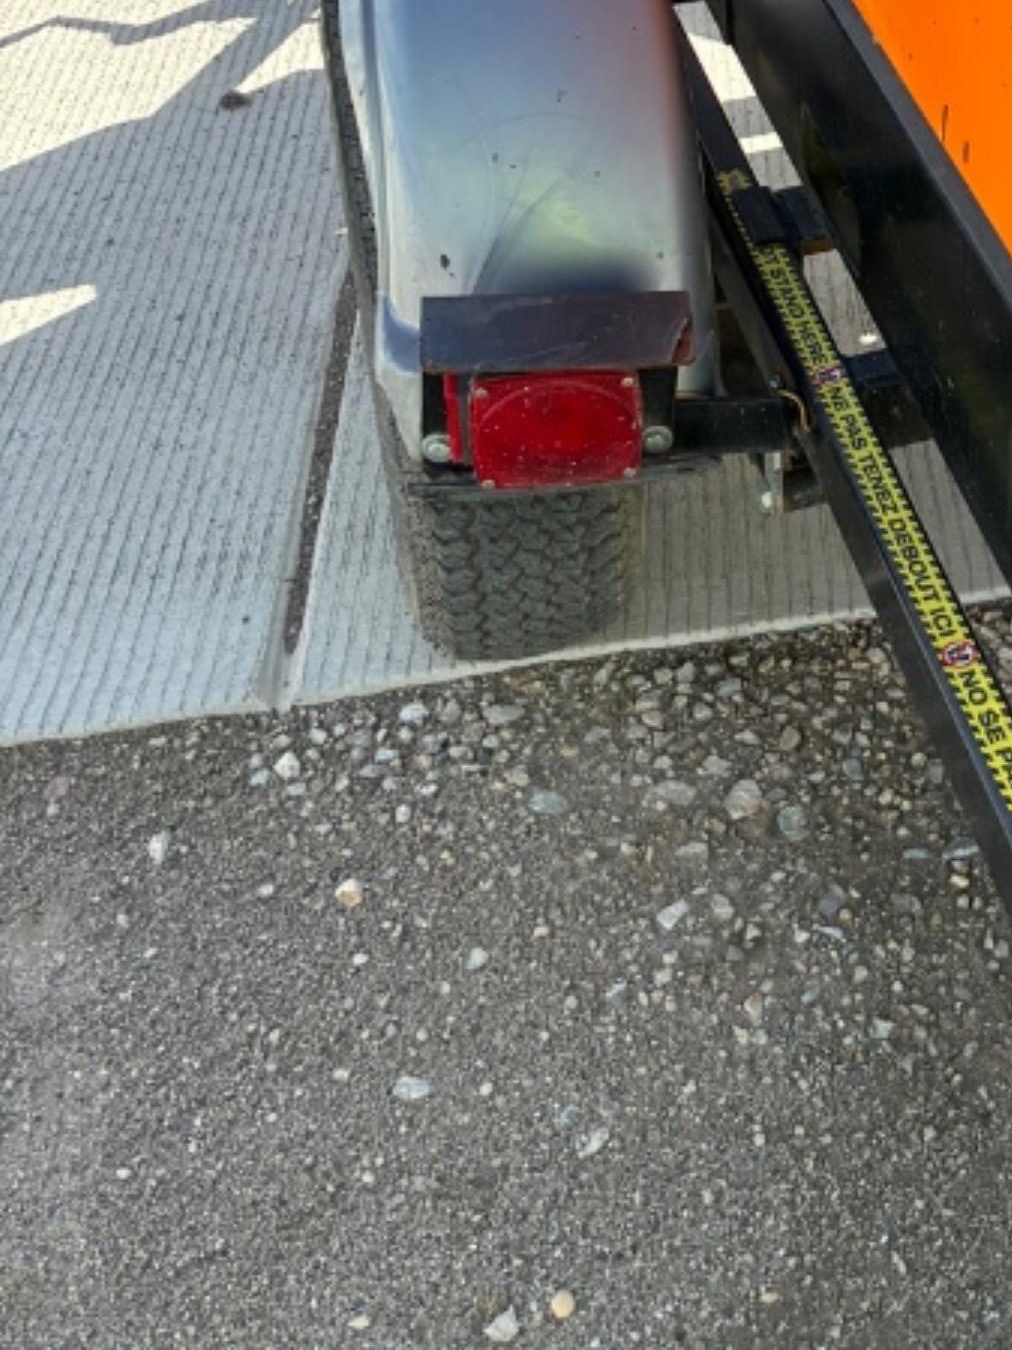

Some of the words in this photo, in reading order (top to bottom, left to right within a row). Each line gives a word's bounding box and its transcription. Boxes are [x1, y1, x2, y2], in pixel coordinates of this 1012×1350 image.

[842, 414, 867, 450] PAS
[888, 517, 940, 602] DEBOUT
[960, 672, 987, 705] NO
[978, 711, 1006, 745] SE
